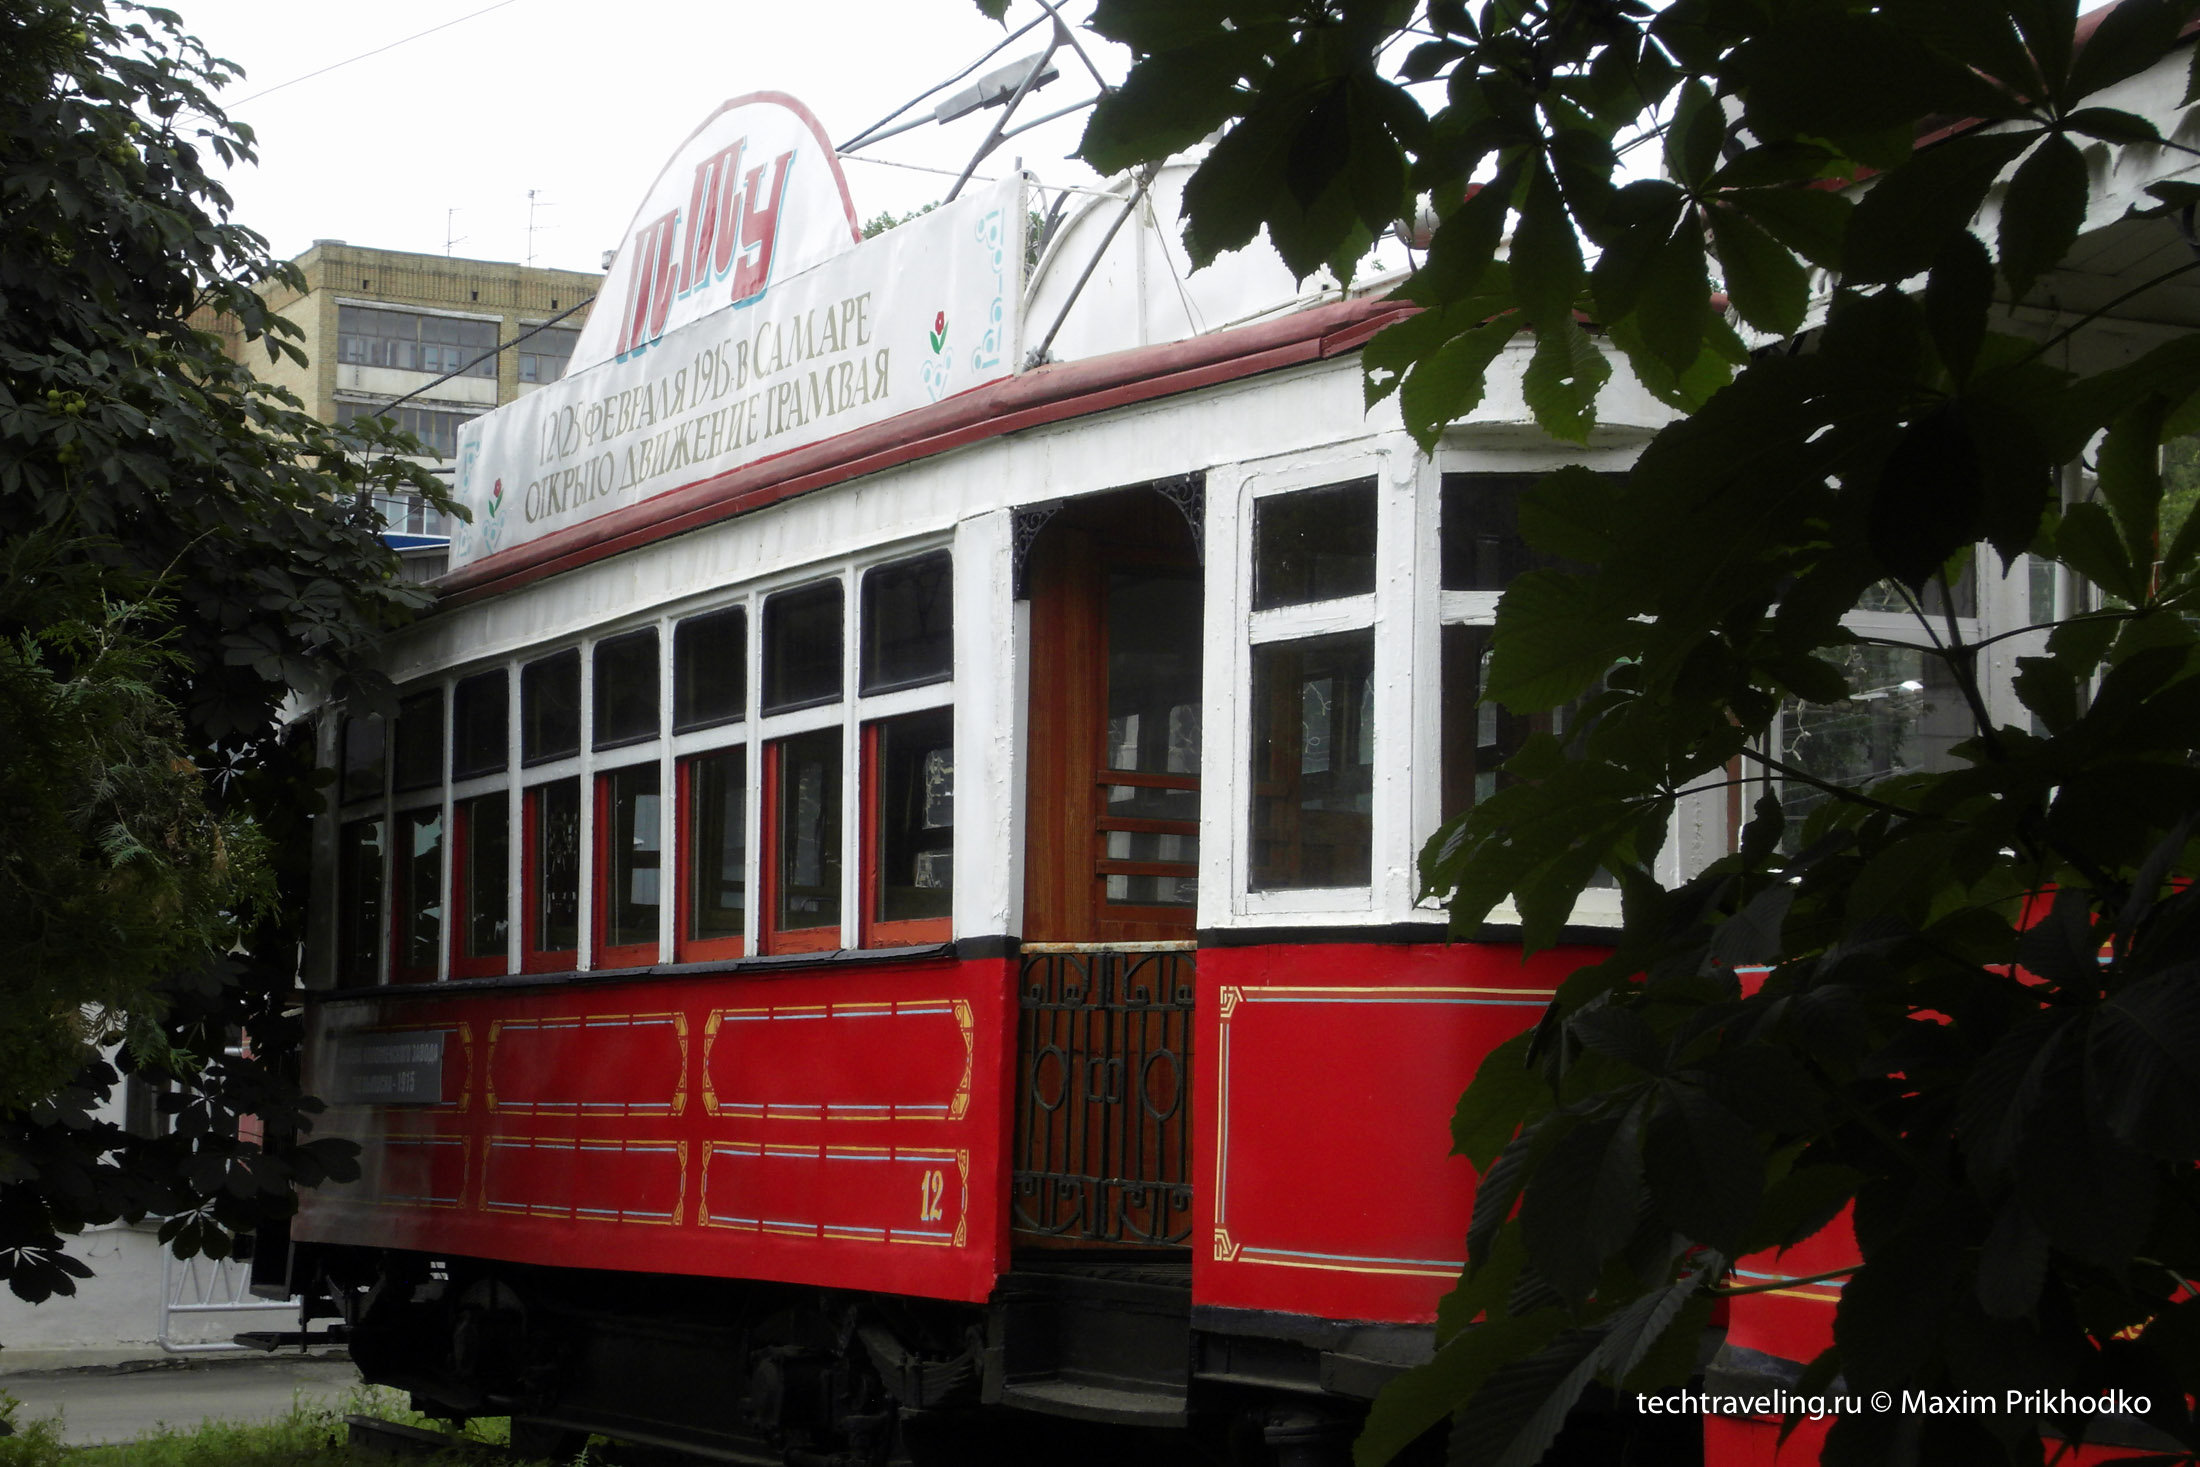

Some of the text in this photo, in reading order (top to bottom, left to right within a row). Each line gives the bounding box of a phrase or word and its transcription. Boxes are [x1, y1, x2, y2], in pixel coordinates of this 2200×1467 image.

[525, 347, 889, 523] ОТКРЫТО ДВИЖЕНИЕ ТРАМВАЯ
[585, 367, 687, 447] ФЕВРАЛЯ
[753, 291, 871, 380] САМАРЕ
[921, 1170, 943, 1221] 12
